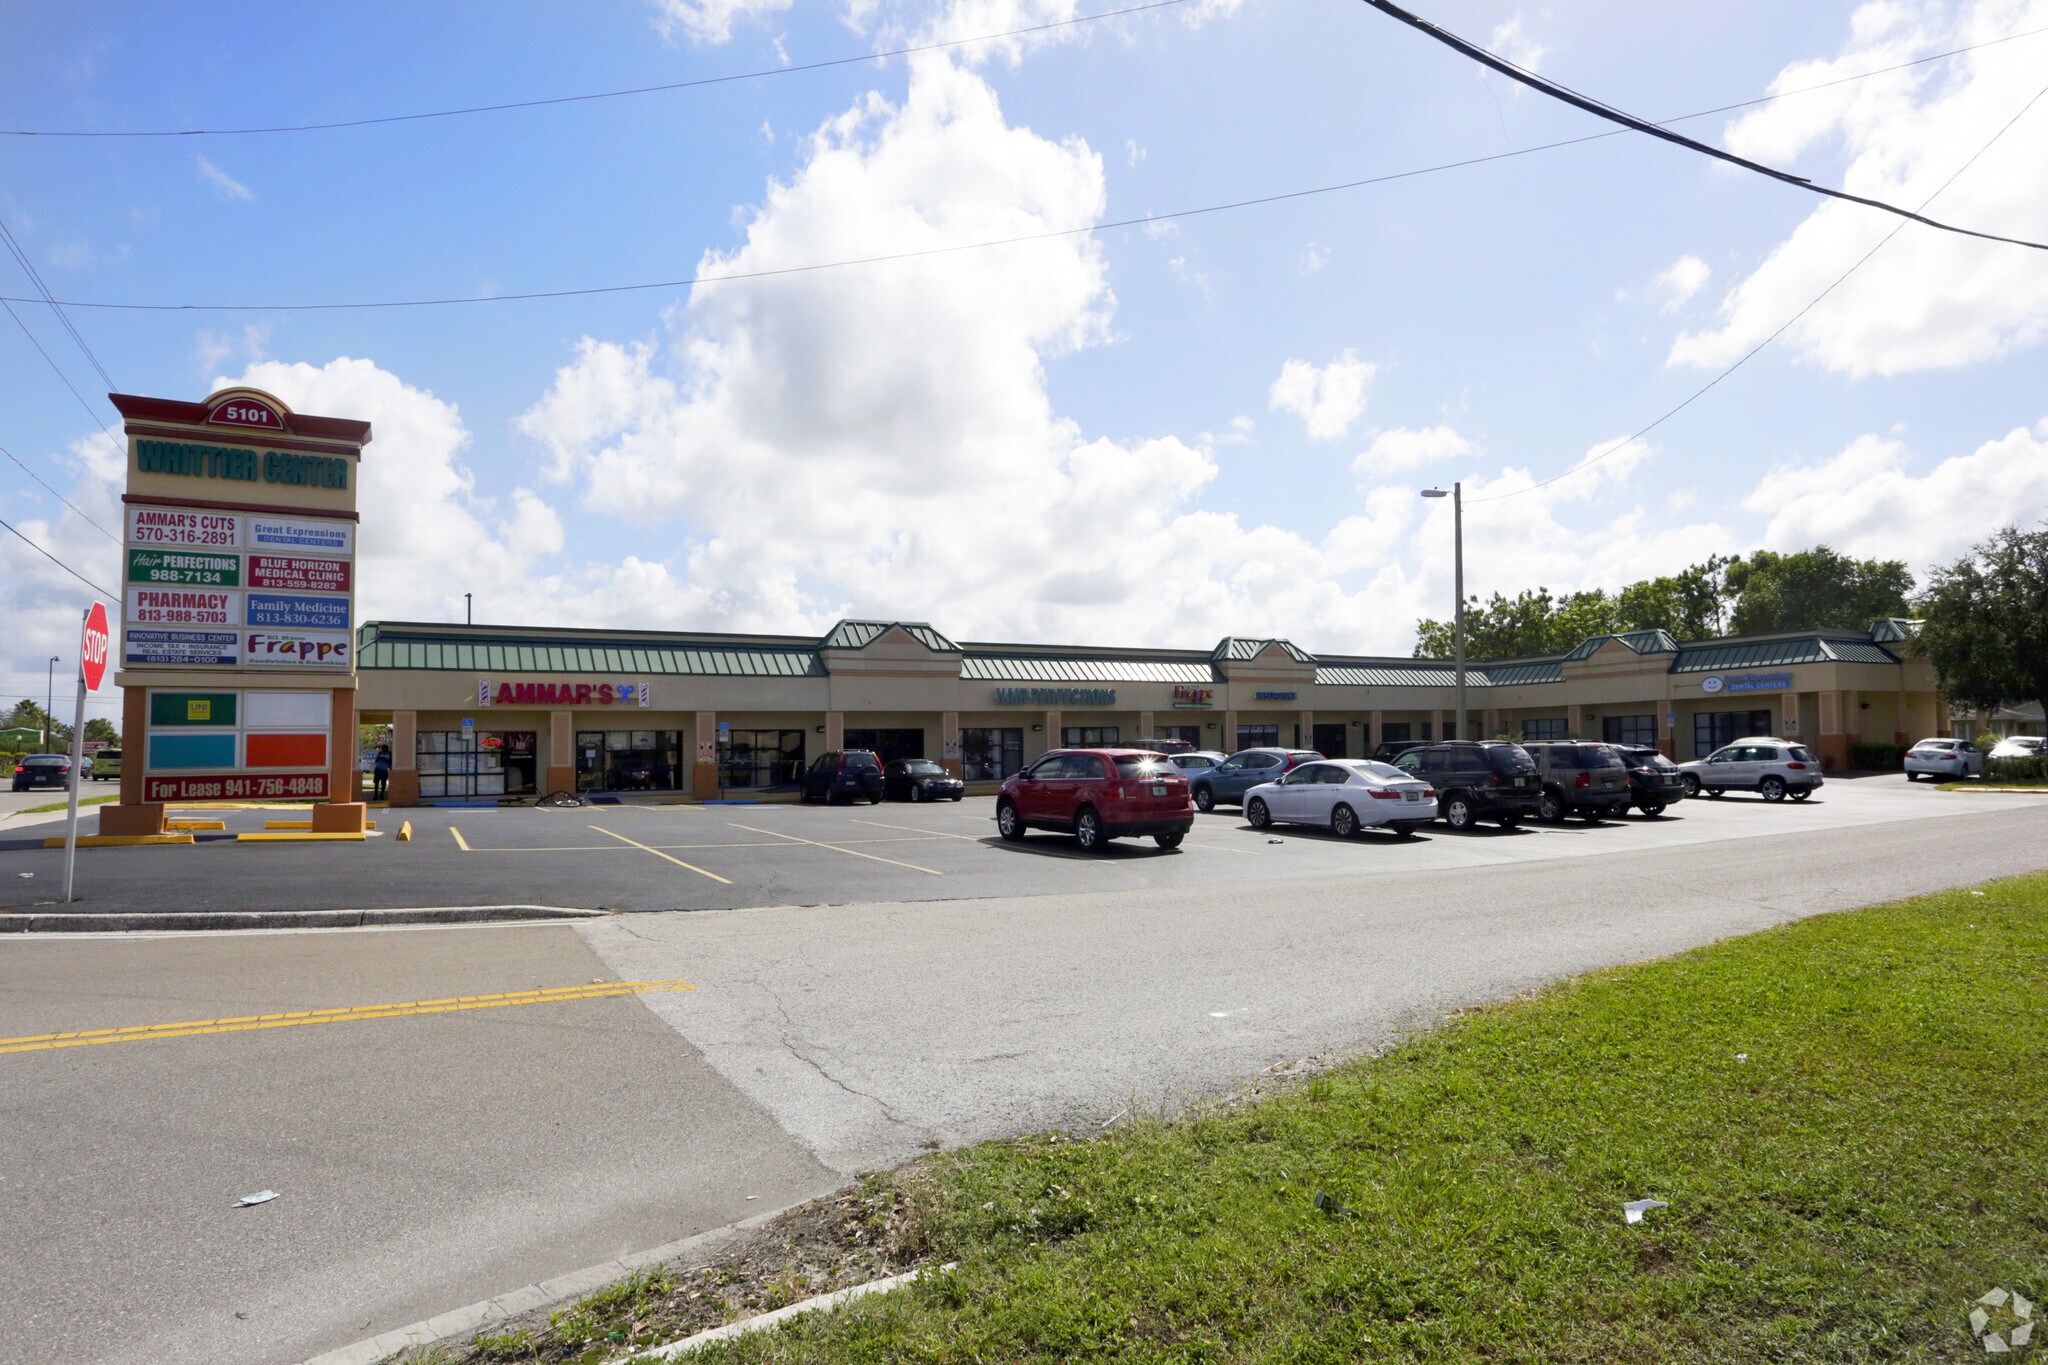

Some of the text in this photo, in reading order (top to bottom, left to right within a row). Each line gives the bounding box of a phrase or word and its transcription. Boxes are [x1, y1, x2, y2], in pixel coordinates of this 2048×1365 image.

[227, 407, 268, 422] 5101
[136, 439, 348, 489] WHITTIER CENTER
[136, 512, 235, 531] AMMAR'S CUTS
[136, 527, 235, 545] 570-316-2891
[255, 524, 346, 538] Great Expressions
[264, 535, 338, 546] DENTAL CENTERS
[133, 553, 236, 571] Hair PERFECTIONS
[260, 558, 340, 571] BLUE HORIZON
[150, 569, 221, 583] 988-7134
[255, 568, 344, 581] MEDICAL CLINIC
[263, 579, 336, 590] 813-559-8282
[137, 592, 228, 609] PHARMACY
[250, 600, 347, 614] Family Medicine
[138, 609, 227, 623] 813-988-5703
[256, 612, 341, 625] 813-830-6236
[129, 632, 169, 640] INNOVATIVE
[171, 633, 206, 641] BUSINESS
[84, 628, 107, 665] STOP
[248, 634, 347, 660] Frappe
[147, 655, 168, 663] (813)
[496, 682, 613, 705] AMMAR'S
[152, 777, 323, 798] For Lease 941-756-4848
